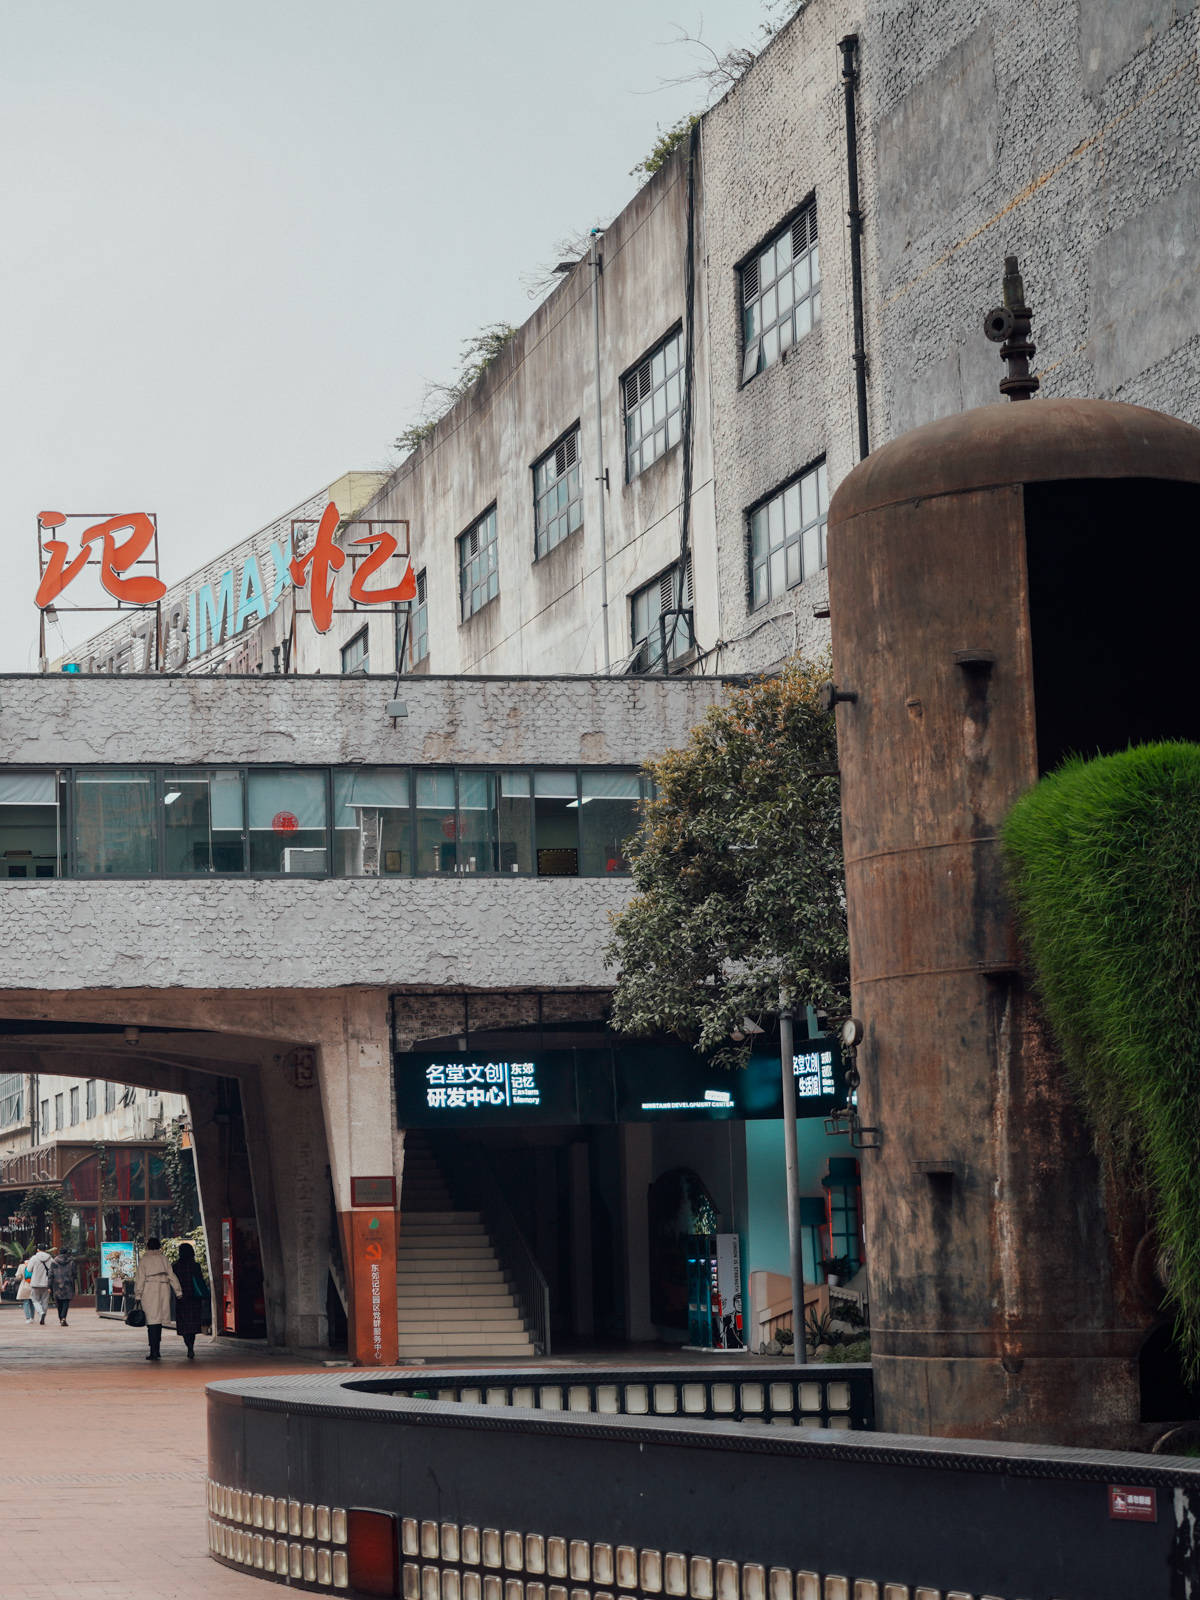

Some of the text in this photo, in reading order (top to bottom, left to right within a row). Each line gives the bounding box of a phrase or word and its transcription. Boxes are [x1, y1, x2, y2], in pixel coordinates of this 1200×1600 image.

[188, 526, 299, 659] IMAX
[426, 1063, 504, 1084] 名堂文创
[511, 1063, 534, 1075] 东郊
[511, 1076, 535, 1088] 记忆
[427, 1086, 505, 1107] 研发中心
